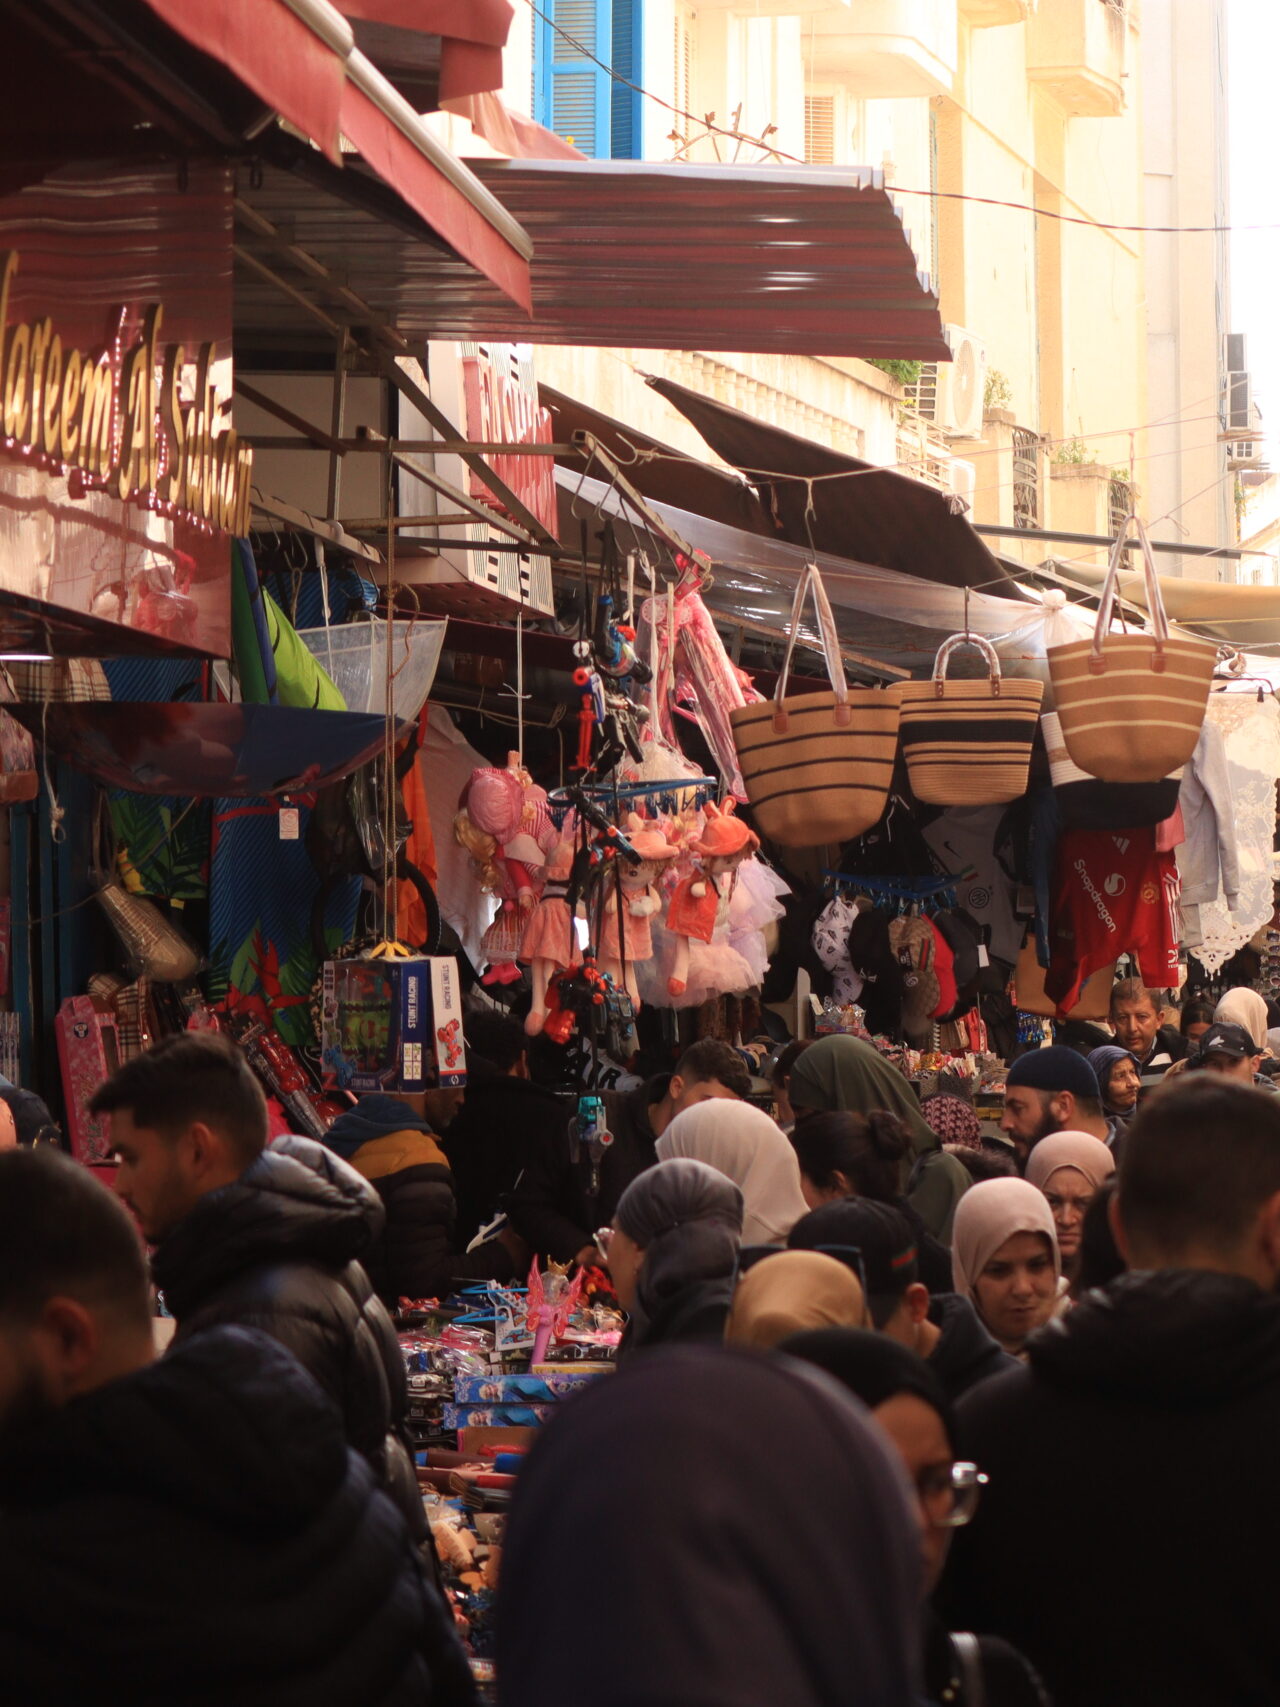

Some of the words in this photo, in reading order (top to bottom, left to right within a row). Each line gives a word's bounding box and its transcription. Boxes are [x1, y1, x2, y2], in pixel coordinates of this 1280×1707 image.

[1074, 859, 1117, 933] Snapdragon
[442, 964, 450, 985] STUNT
[407, 976, 417, 1004] RACING
[443, 986, 452, 1010] RACING
[407, 1004, 417, 1029] STUNT
